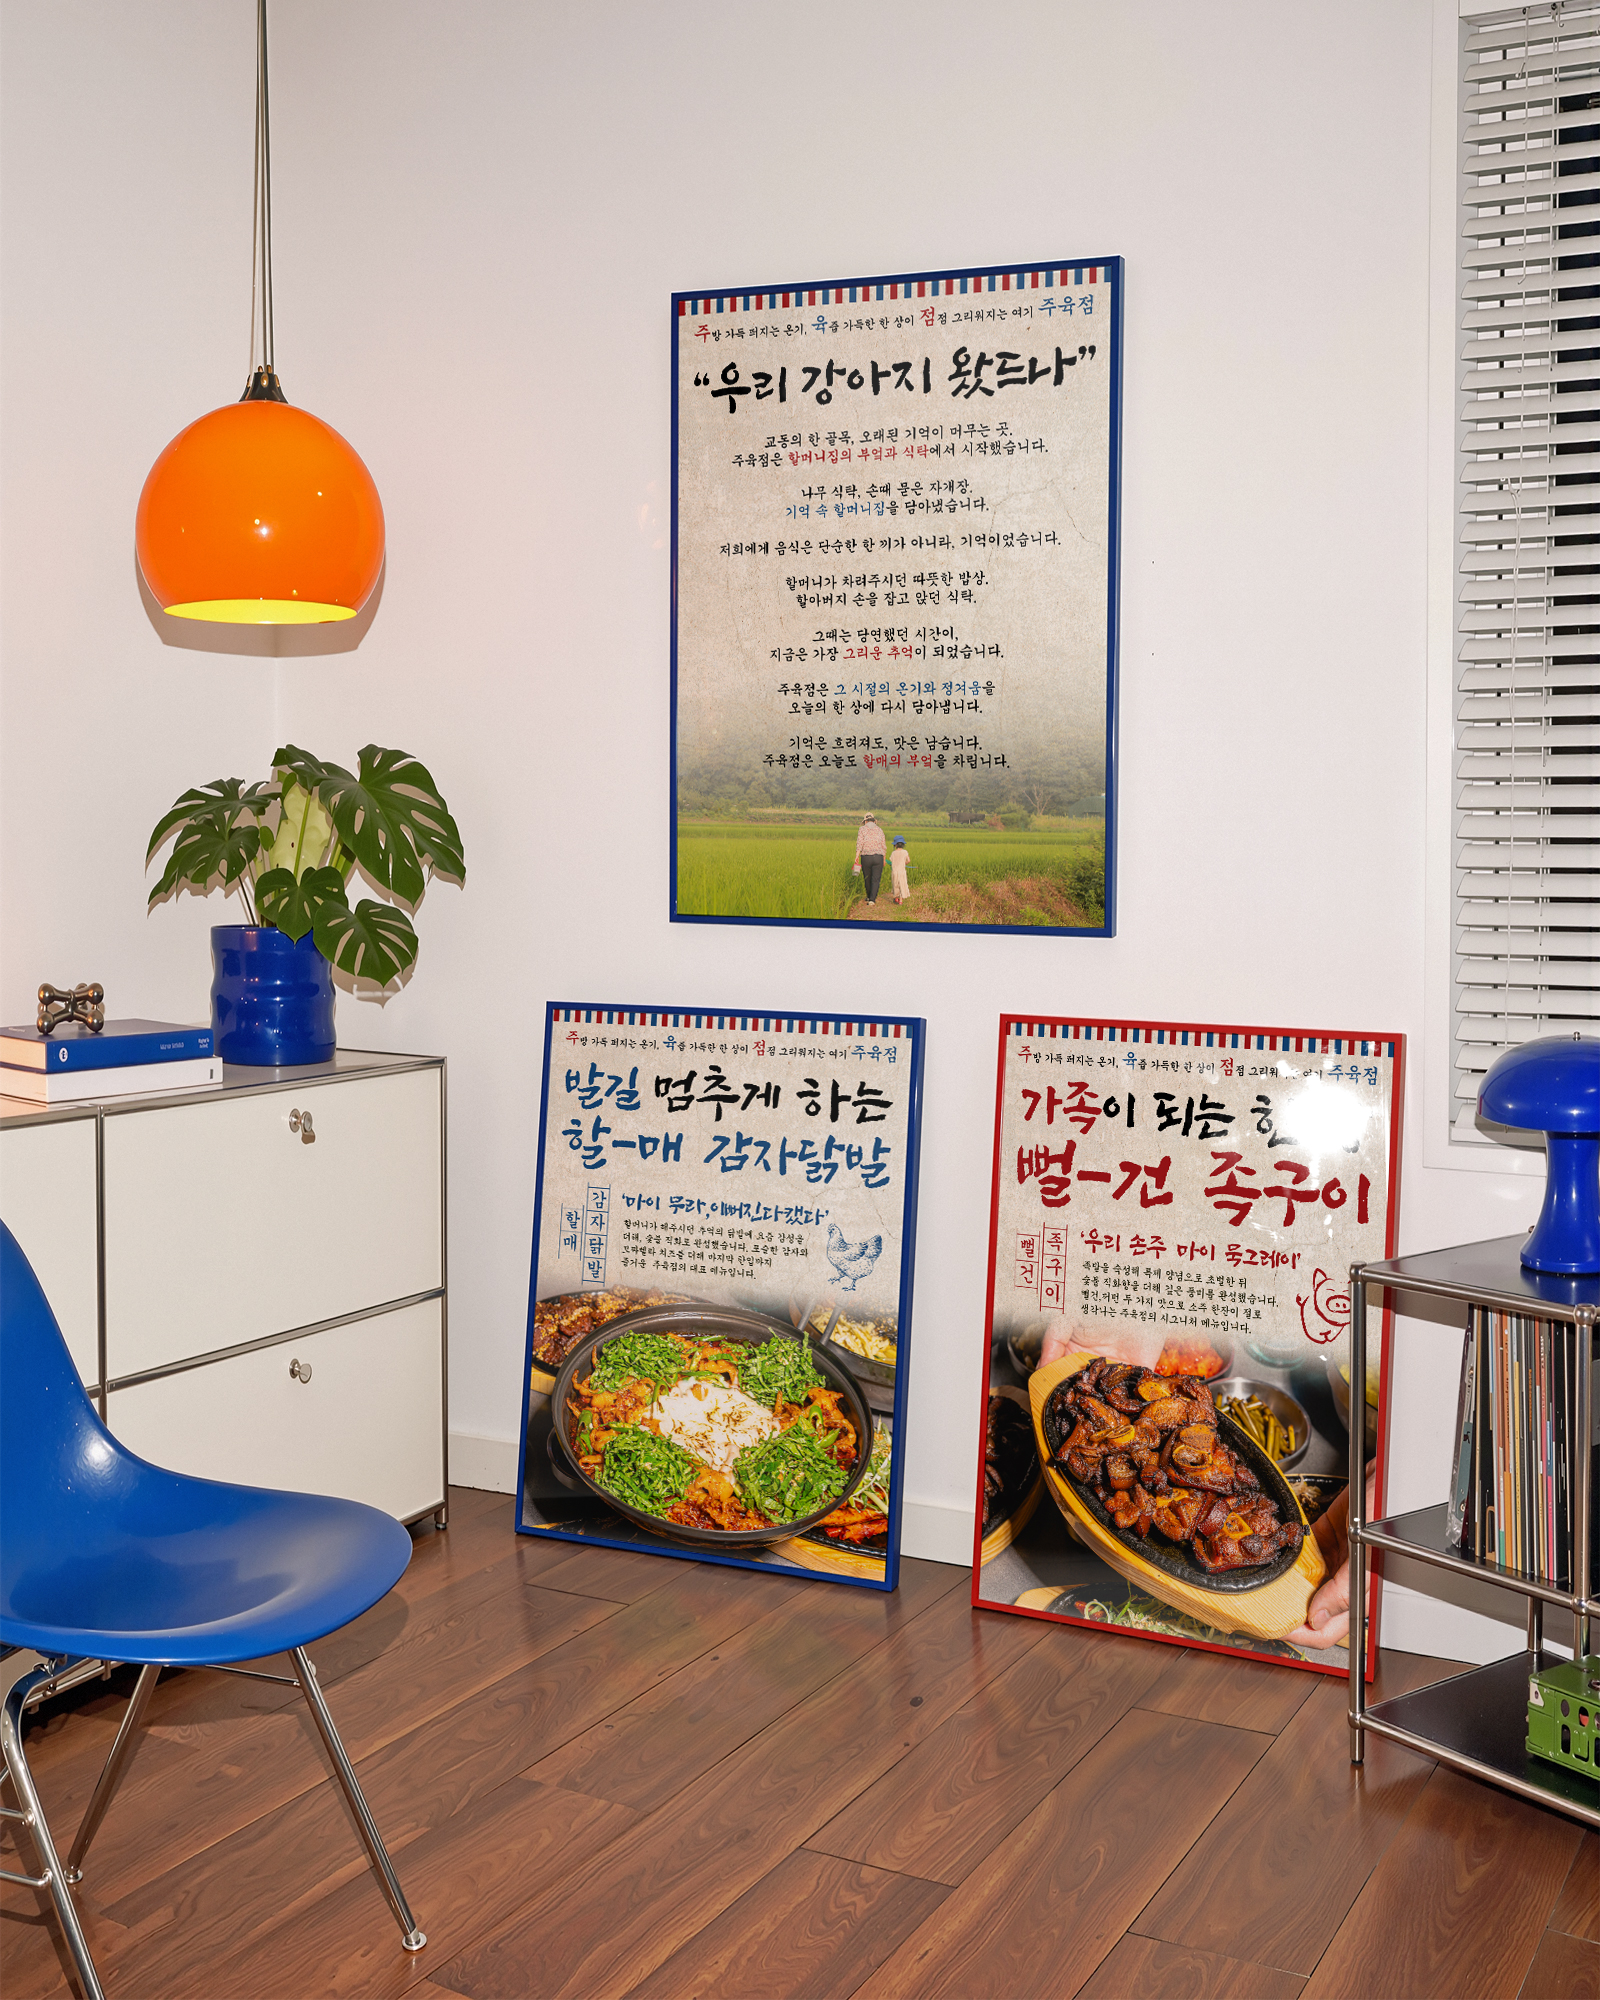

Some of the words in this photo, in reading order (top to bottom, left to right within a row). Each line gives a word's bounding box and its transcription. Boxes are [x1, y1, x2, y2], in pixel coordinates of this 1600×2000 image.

[693, 323, 722, 343] 주방
[724, 327, 746, 339] 가득
[748, 324, 780, 339] 퍼지는
[782, 322, 807, 336] 온기,
[810, 314, 839, 334] 육즙
[842, 316, 875, 332] 가득한
[878, 315, 890, 329] 한
[893, 314, 914, 328] 상이
[919, 305, 947, 327] 점점
[951, 307, 1008, 323] 그리워지는
[1011, 304, 1033, 319] 여기
[1037, 293, 1093, 317] 주육점
[800, 355, 931, 406] 강아지
[763, 432, 802, 449] 교동의
[807, 431, 820, 447] 한
[824, 429, 854, 446] 골목,
[858, 426, 898, 443] 오래된
[904, 424, 943, 441] 기억이
[949, 422, 991, 439] 머무는
[995, 421, 1013, 437] 곳.
[731, 451, 783, 468] 주육점은
[787, 447, 851, 466] 할머니집의
[856, 444, 898, 462] 부엌과
[902, 441, 955, 459] 식탁에서
[960, 437, 1048, 457] 시작했습니다.
[800, 484, 826, 501] 나무
[830, 483, 861, 500] 식탁,
[865, 481, 891, 498] 손때
[896, 480, 924, 497] 묻은
[928, 477, 973, 495] 자개장.
[785, 503, 809, 519] 기억
[814, 503, 828, 518] 속
[833, 499, 899, 518] 할머니집을
[903, 495, 989, 515] 담아냈습니다.
[719, 540, 769, 557] 저희에게
[773, 539, 813, 556] 음식은
[817, 537, 857, 554] 단순한
[861, 536, 875, 553] 한
[878, 535, 906, 552] 끼가
[910, 533, 955, 550] 아니라,
[960, 529, 1061, 548] 기억이었습니다.
[784, 574, 837, 591] 할머니가
[841, 571, 906, 588] 차려주시던
[912, 570, 954, 587] 따뜻한
[957, 569, 989, 586] 밥상.
[795, 591, 846, 609] 할아버지
[851, 591, 878, 607] 손을
[883, 590, 910, 606] 잡고
[914, 588, 940, 605] 앉던
[946, 587, 977, 605] 식탁.
[811, 627, 852, 643] 그때는
[856, 626, 908, 643] 당연했던
[914, 625, 958, 642] 시간이,
[769, 646, 808, 662] 지금은
[812, 645, 839, 662] 가장
[842, 644, 882, 661] 그리운
[886, 643, 926, 660] 추억이
[931, 642, 1004, 659] 되었습니다.
[776, 681, 829, 698] 주육점은
[833, 683, 846, 695] 그
[851, 680, 889, 697] 시절의
[895, 680, 936, 696] 온기와
[941, 679, 995, 696] 정겨움을
[787, 699, 826, 716] 오늘의
[831, 699, 845, 715] 한
[849, 698, 874, 715] 상에
[879, 698, 905, 714] 다시
[911, 697, 982, 715] 담아냅니다.
[788, 734, 827, 751] 기억은
[831, 734, 888, 750] 흐려져도,
[893, 734, 920, 751] 맛은
[924, 734, 982, 751] 남습니다.
[762, 752, 813, 768] 주육점은
[818, 753, 857, 769] 오늘도
[862, 753, 900, 769] 할매의
[906, 753, 947, 769] 부엌을
[952, 752, 1010, 769] 차립니다.
[1017, 1044, 1042, 1064] 주방
[1044, 1051, 1063, 1065] 가득
[1065, 1053, 1094, 1067] 퍼지는
[1096, 1055, 1118, 1069] 온기,
[1121, 1050, 1147, 1071] 육즙
[1150, 1058, 1180, 1073] 가득한
[1218, 1056, 1244, 1077] 점점
[1326, 1063, 1377, 1086] 주육점
[564, 1061, 641, 1111] 발길
[653, 1064, 782, 1122] 멈추게
[795, 1077, 894, 1125] 하는
[1020, 1080, 1136, 1135] 가족이
[1152, 1091, 1236, 1140] 되는
[702, 1130, 891, 1189] 감자닭발
[1202, 1150, 1371, 1227] 족구이
[1128, 1233, 1167, 1259] 손주
[1176, 1240, 1215, 1262] 마이
[1081, 1259, 1110, 1274] 족발을
[1111, 1262, 1140, 1277] 숙성해
[1165, 1268, 1203, 1283] 양념으로
[1204, 1274, 1236, 1288] 초벌한
[1237, 1276, 1247, 1289] 뒤
[1081, 1274, 1100, 1287] 숯불
[1102, 1276, 1140, 1292] 직화향을
[1142, 1280, 1161, 1294] 더해
[1164, 1283, 1183, 1297] 깊은
[1185, 1285, 1215, 1301] 풍미를
[1217, 1289, 1279, 1308] 완성했습니다.
[1080, 1302, 1117, 1318] 생각나는
[1118, 1307, 1157, 1322] 주육점의
[1159, 1312, 1197, 1327] 시그니처
[1200, 1317, 1251, 1334] 메뉴입니다.
[1122, 1293, 1132, 1305] 두
[1135, 1294, 1153, 1308] 가지
[1156, 1297, 1185, 1310] 맛으로
[1187, 1301, 1207, 1313] 소주
[1210, 1303, 1239, 1318] 한잔이
[1242, 1306, 1262, 1320] 절로
